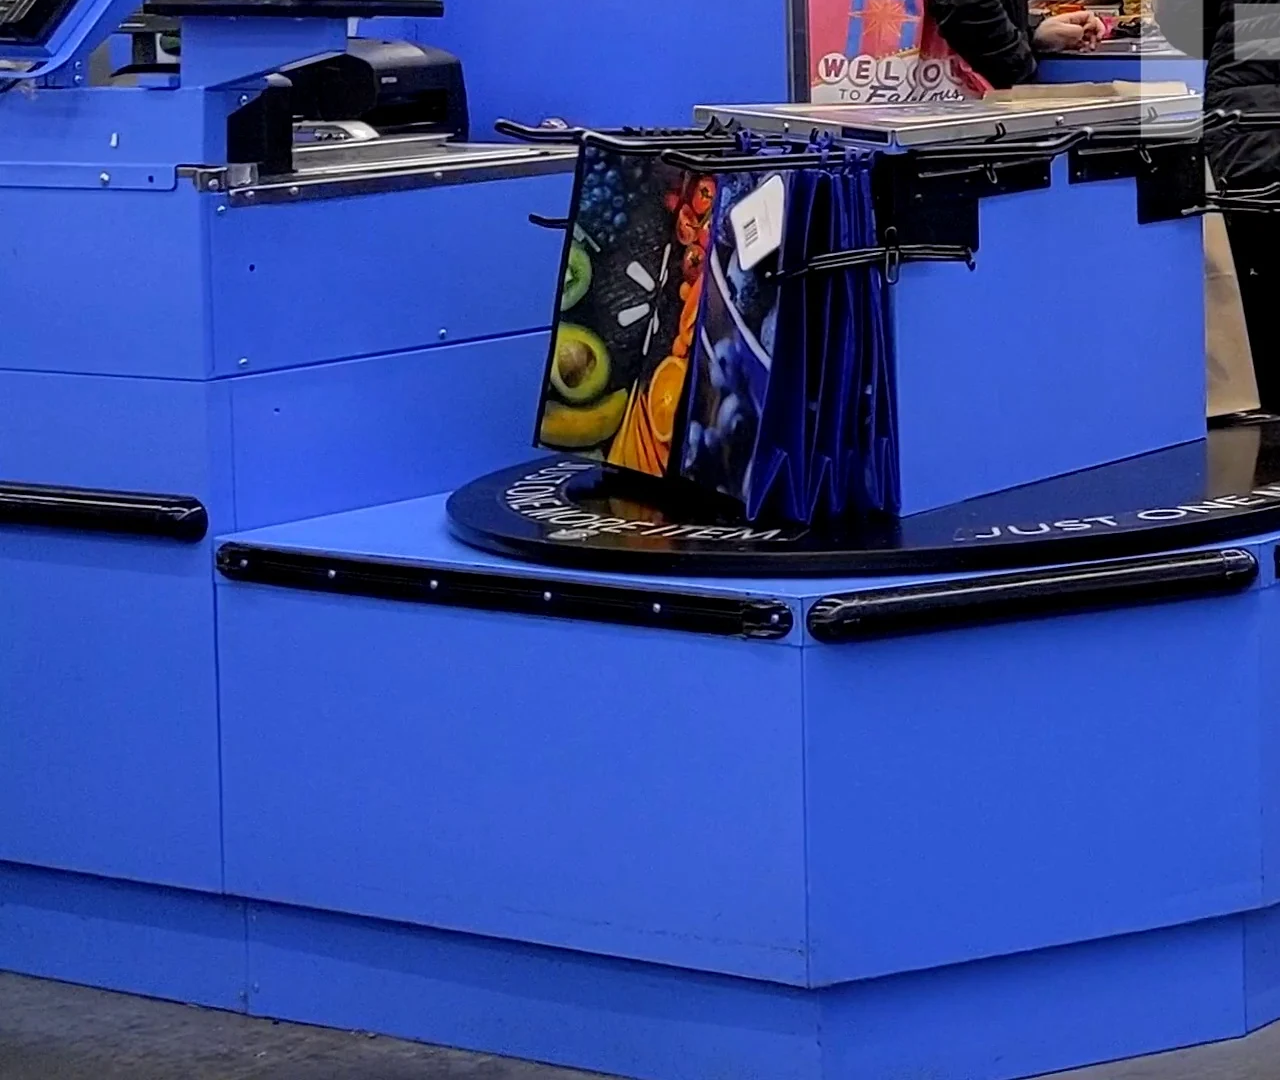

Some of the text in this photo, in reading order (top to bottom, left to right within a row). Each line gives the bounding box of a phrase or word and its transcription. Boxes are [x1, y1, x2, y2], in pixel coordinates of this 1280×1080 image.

[839, 88, 861, 101] TO
[505, 461, 787, 542] JUST ONE MORE ITEM
[974, 515, 1118, 540] JUST
[1137, 494, 1266, 520] ONE
